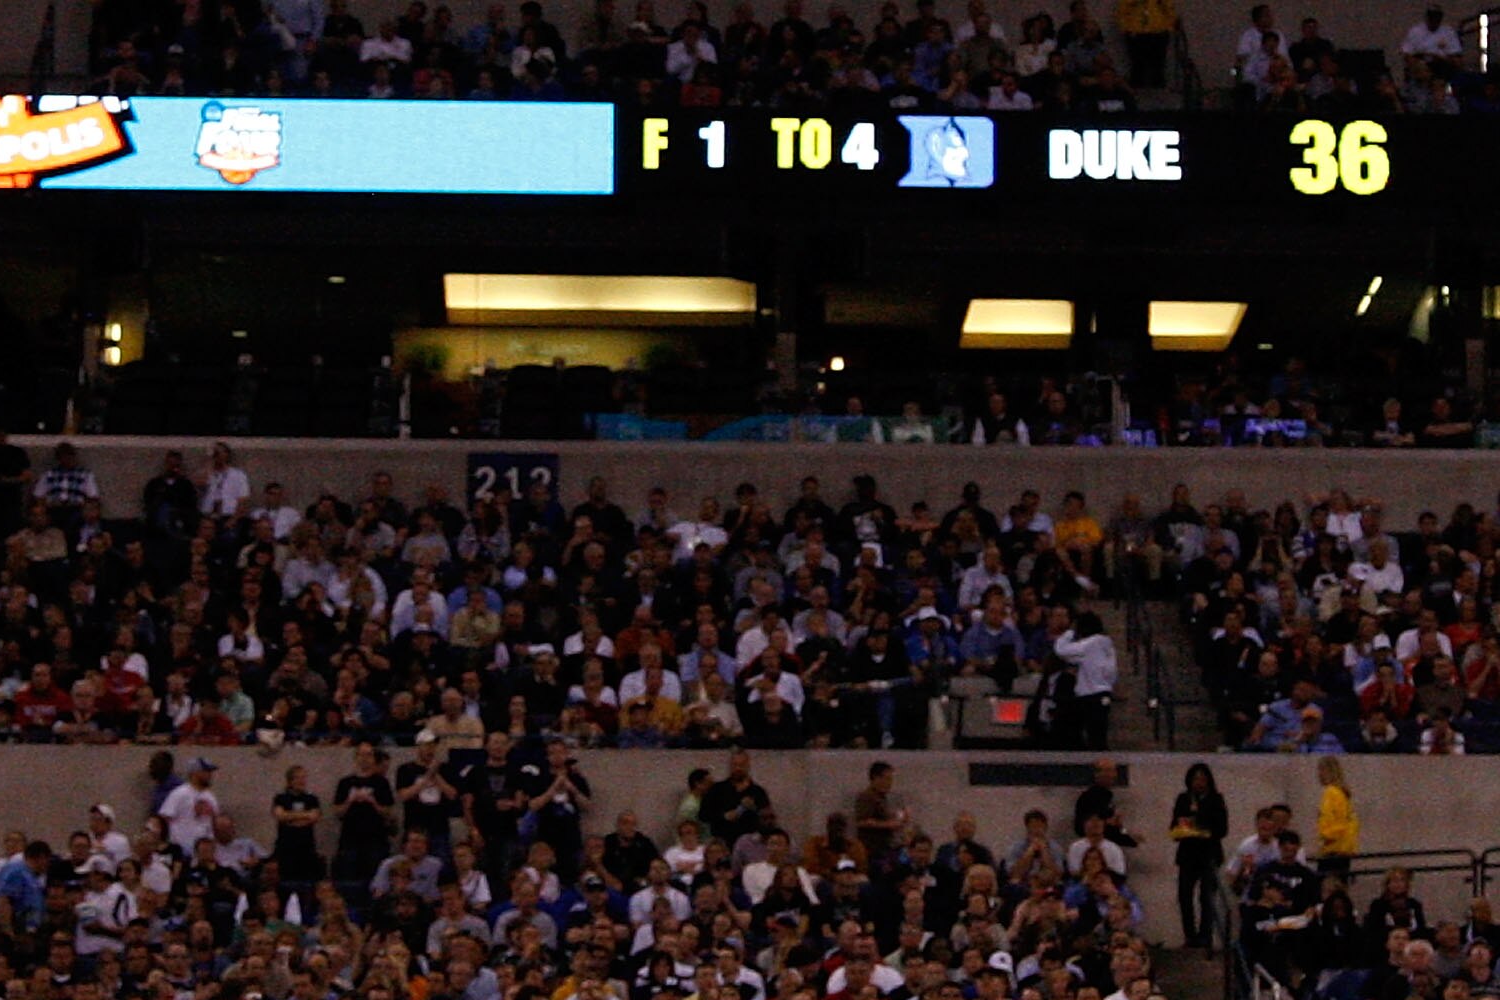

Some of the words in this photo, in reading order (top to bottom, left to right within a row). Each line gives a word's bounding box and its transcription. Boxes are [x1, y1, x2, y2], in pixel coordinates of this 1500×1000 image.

[642, 118, 669, 169] F
[698, 120, 726, 169] 1
[770, 117, 832, 170] TO
[840, 121, 880, 170] 4
[1048, 129, 1183, 181] DUKE
[1289, 119, 1390, 196] 36
